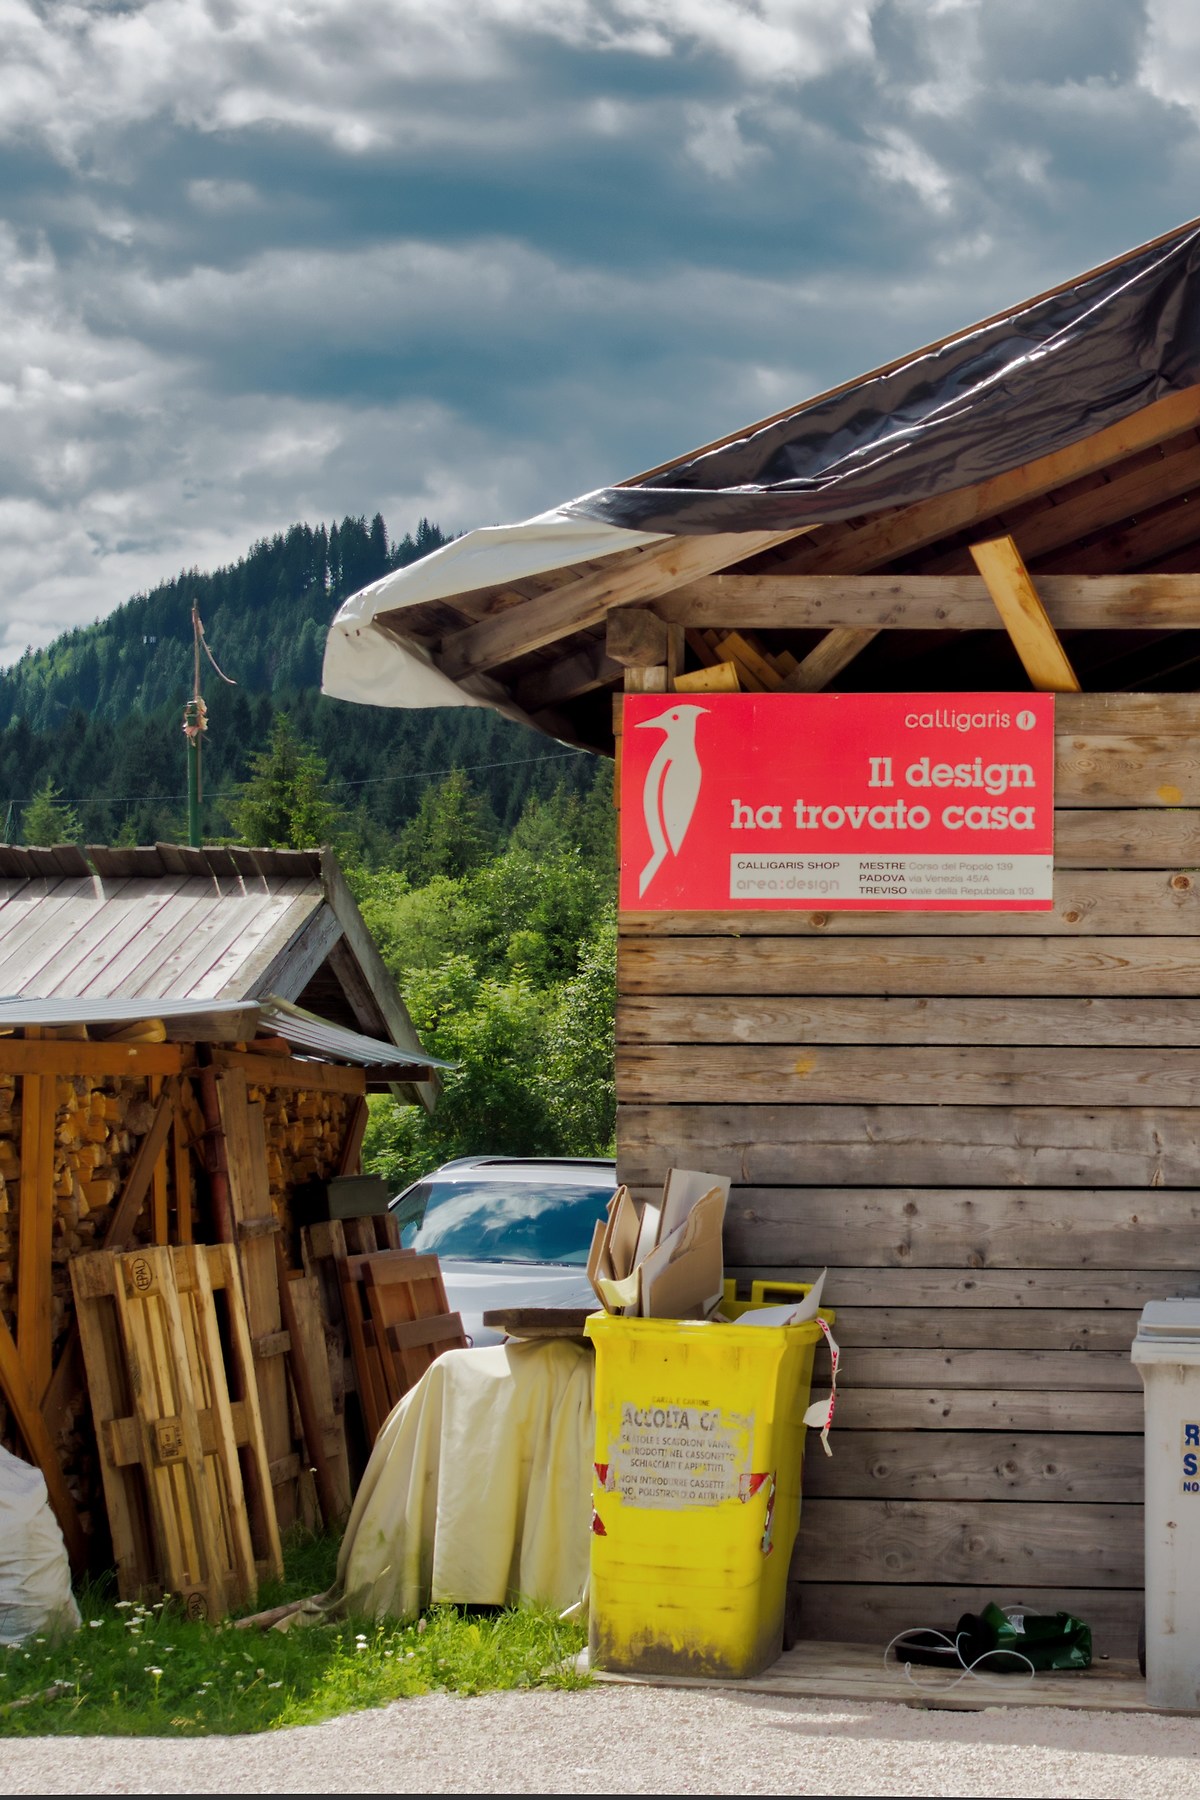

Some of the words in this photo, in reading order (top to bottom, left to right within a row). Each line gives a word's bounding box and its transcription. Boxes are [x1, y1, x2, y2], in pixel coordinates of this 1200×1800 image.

[905, 708, 1011, 733] calligaris
[868, 757, 894, 788] Il
[905, 757, 1036, 796] design
[730, 799, 783, 830] ha
[793, 799, 931, 830] trovato
[941, 804, 1036, 831] casa
[737, 861, 805, 870] CALLIGARIS
[807, 861, 840, 870] SHOP
[859, 862, 906, 871] MESTRE
[908, 862, 939, 871] Corso
[941, 862, 957, 871] del
[959, 862, 994, 872] Popolo
[996, 863, 1013, 871] 139
[859, 874, 906, 882] PADOVA
[908, 874, 922, 882] via
[925, 874, 964, 883] Venezia
[859, 886, 907, 895] TREVISO
[909, 887, 932, 895] viale
[934, 887, 958, 895] della
[960, 887, 1015, 896] Repubblica
[1018, 887, 1034, 896] 103
[135, 1261, 149, 1287] EPAL
